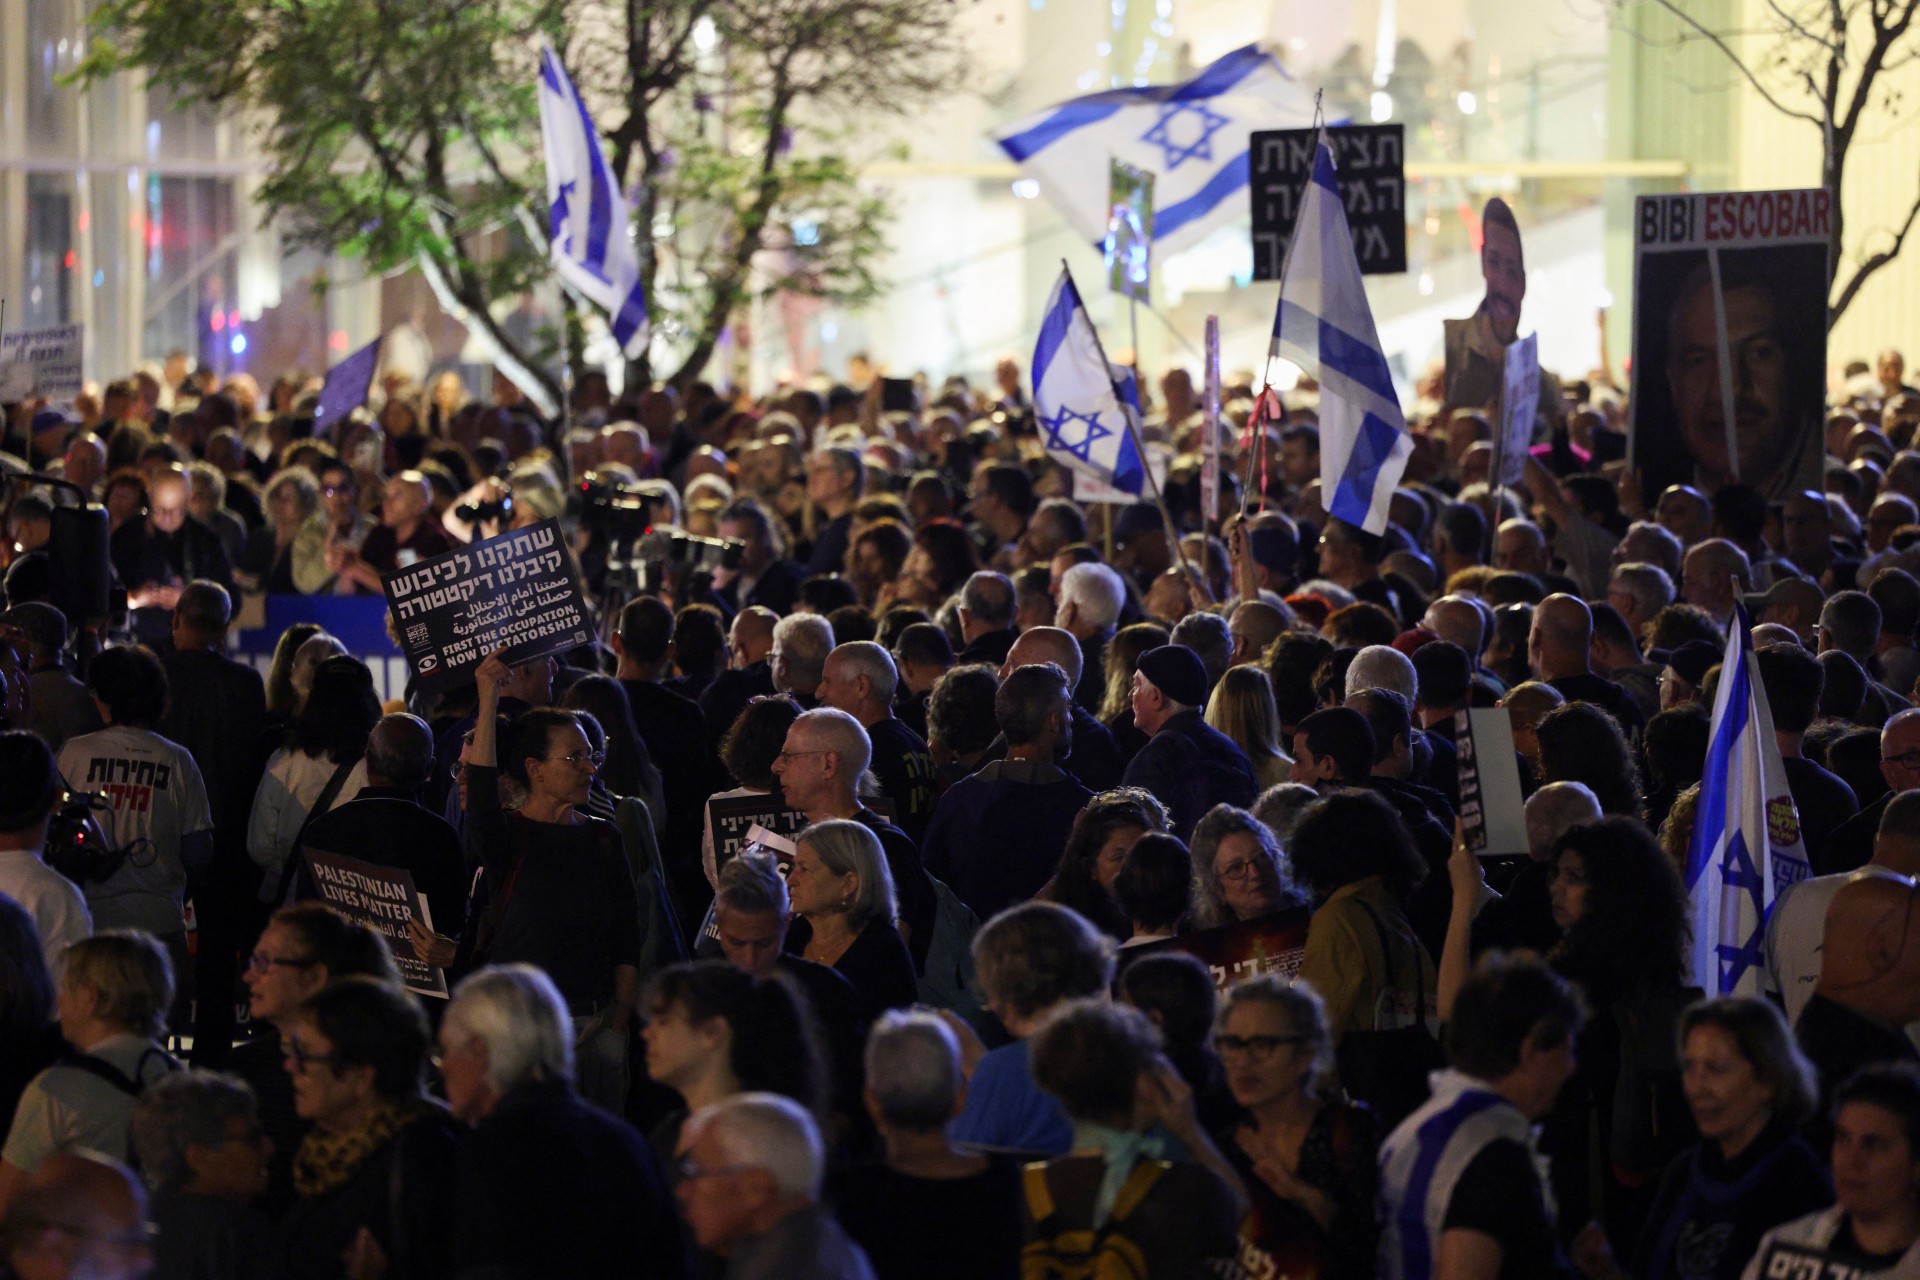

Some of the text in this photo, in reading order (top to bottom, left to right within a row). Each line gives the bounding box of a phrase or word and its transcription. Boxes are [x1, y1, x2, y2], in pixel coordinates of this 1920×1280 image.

[1641, 190, 1830, 244] BIBI ESCOBAR
[390, 527, 555, 598] שתקנו לכיבוש
[397, 550, 563, 620] קיבלנו דיקטטורה
[510, 585, 534, 605] أمام
[534, 576, 569, 594] صمتنا
[453, 589, 573, 636] حصلنا على الديكتاتورية
[466, 592, 509, 619] الاحتلال
[442, 638, 476, 656] FIRST
[476, 631, 498, 646] THE
[499, 604, 579, 635] OCCUPATION,
[446, 650, 480, 668] NOW
[480, 614, 582, 656] DICTATORSHIP
[87, 758, 171, 790] בחירות
[721, 812, 776, 833] מדיני
[314, 863, 408, 902] PALESTINIAN
[322, 883, 360, 907] LIVES
[360, 894, 413, 921] MATTER
